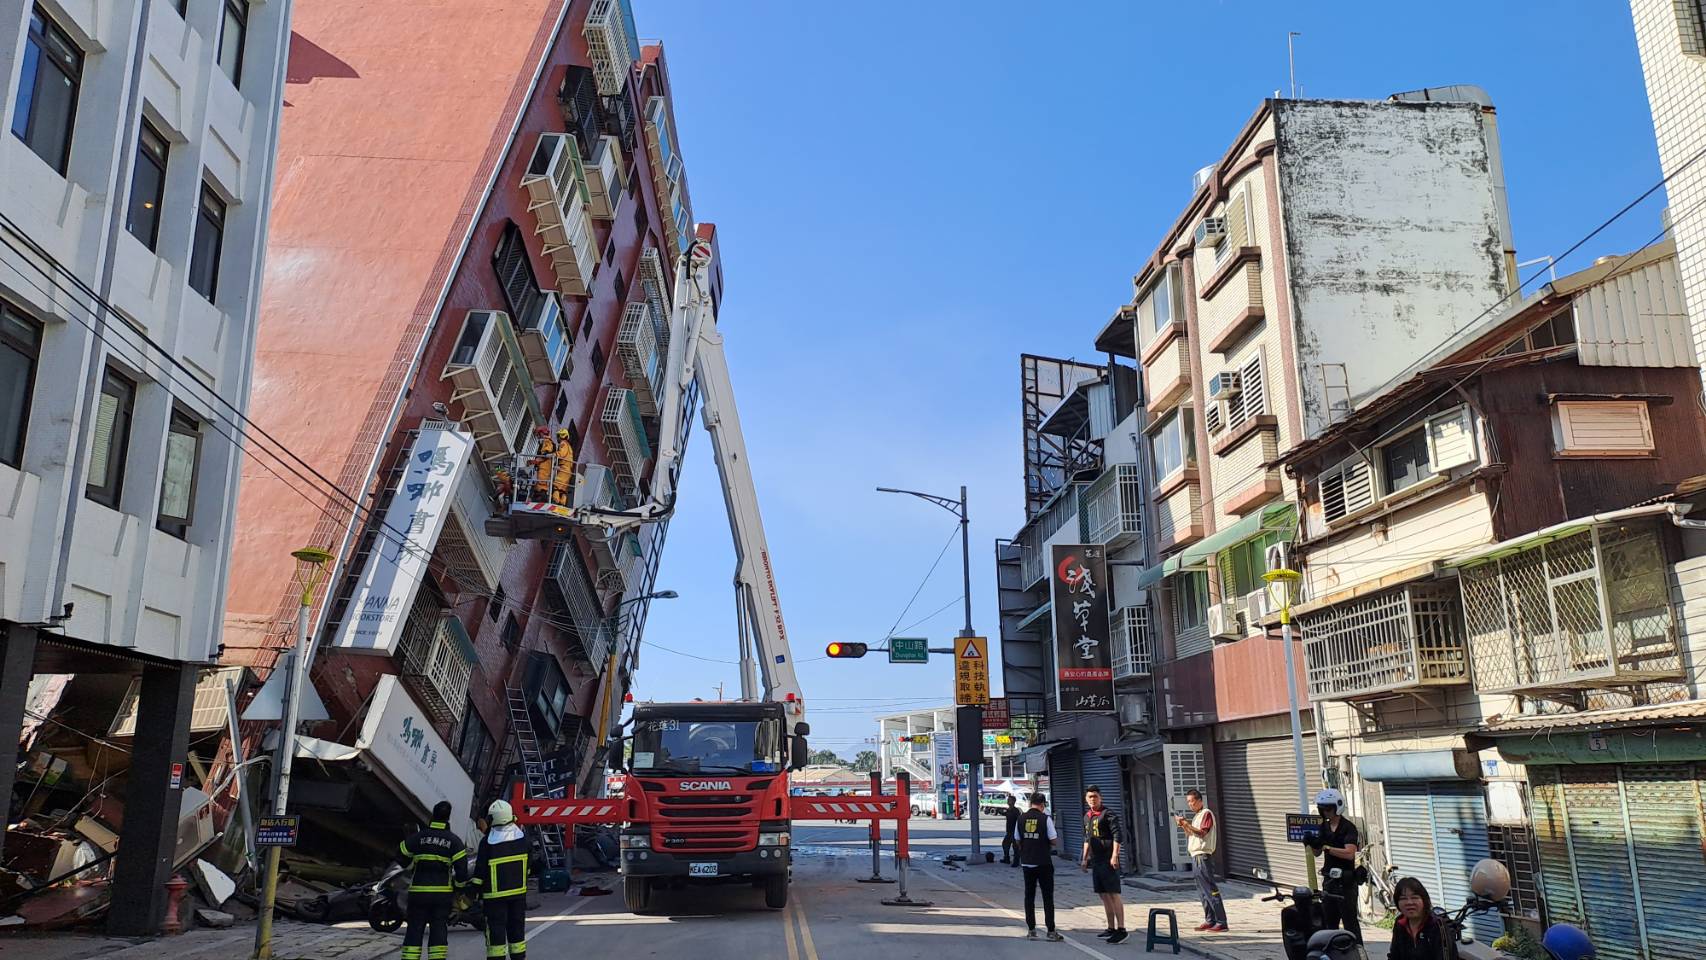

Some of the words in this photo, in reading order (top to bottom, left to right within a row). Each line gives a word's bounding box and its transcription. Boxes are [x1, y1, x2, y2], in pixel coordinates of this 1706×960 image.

[895, 640, 924, 650] 中山路
[958, 660, 971, 703] 違規取締
[973, 660, 987, 702] 科技執法
[679, 781, 732, 791] SCANIA
